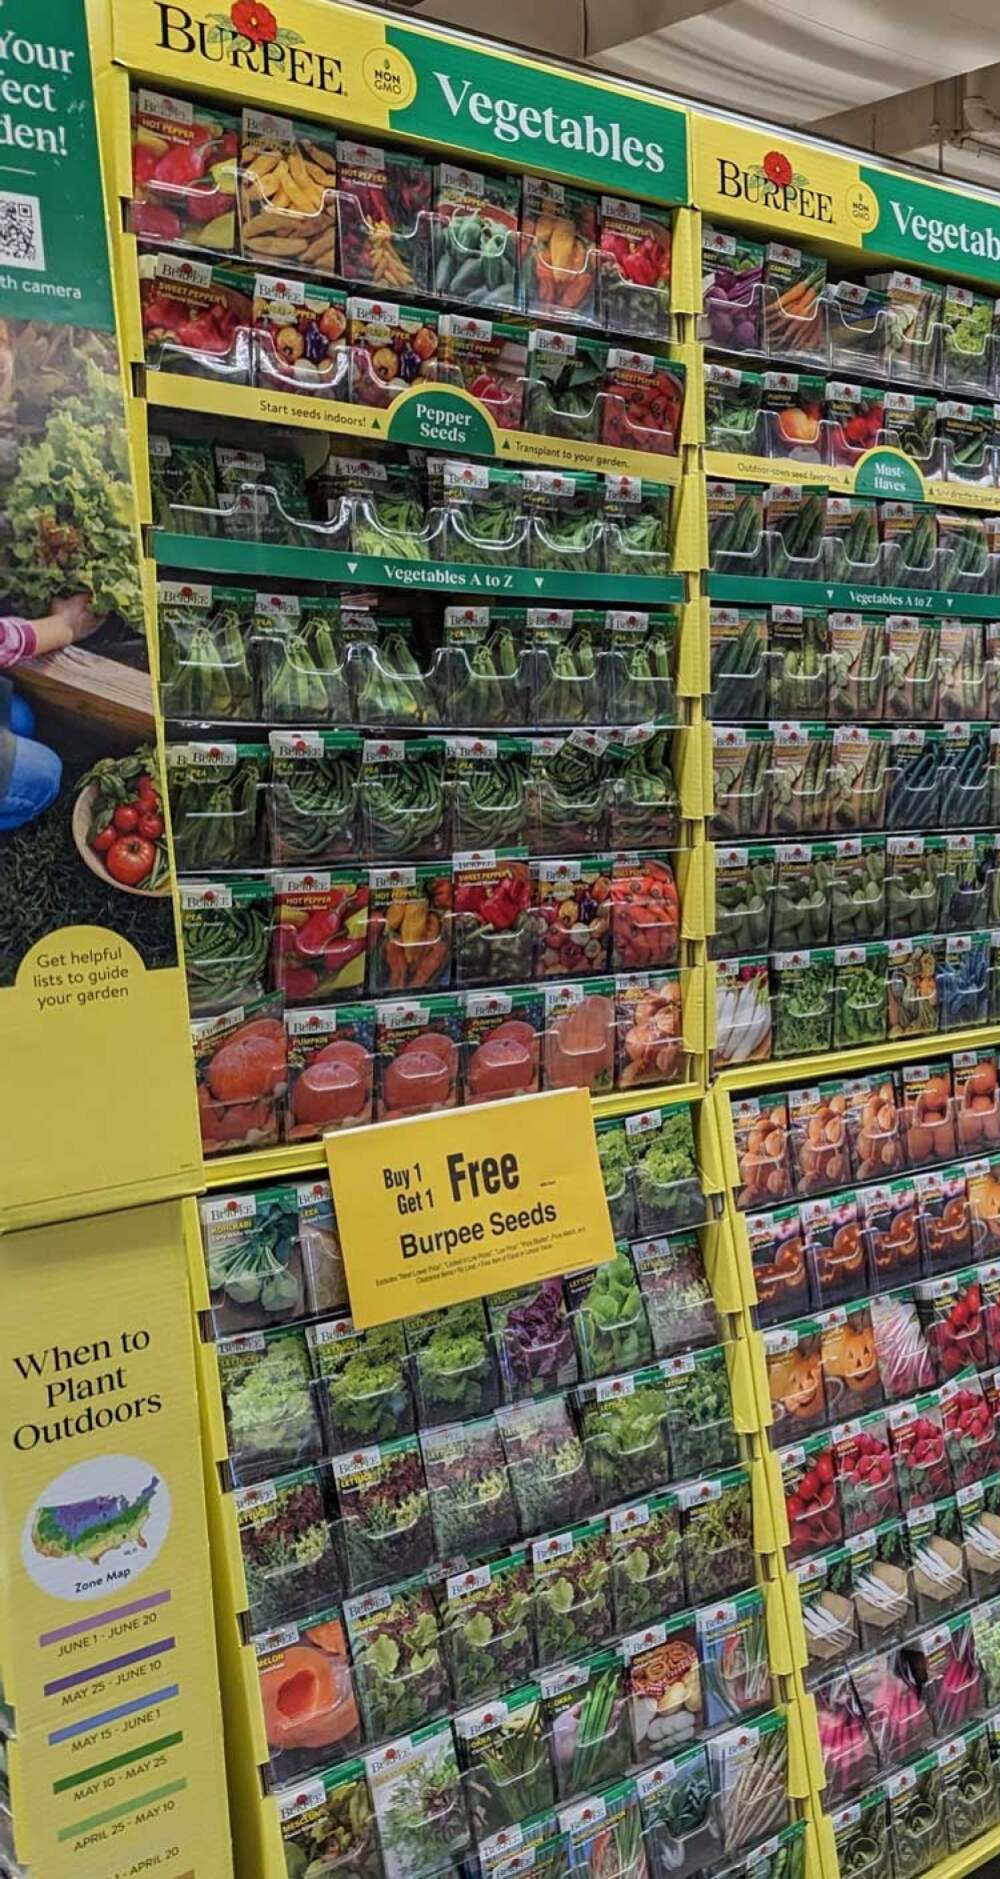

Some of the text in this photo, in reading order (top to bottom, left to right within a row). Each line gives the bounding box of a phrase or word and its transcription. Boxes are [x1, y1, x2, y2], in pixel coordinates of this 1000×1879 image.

[154, 2, 345, 97] BURPEE
[373, 80, 402, 96] GMO
[374, 69, 401, 85] NON
[432, 71, 665, 173] Vegetables
[716, 157, 834, 225] BURPEE
[851, 210, 871, 222] GMO
[852, 202, 871, 214] NON
[22, 277, 82, 300] camera
[259, 400, 367, 428] Start seeds indoors!
[416, 403, 472, 427] Pepper
[420, 423, 467, 444] Seeds
[515, 441, 630, 469] Transplant to your garden.
[872, 476, 907, 493] Haves
[874, 462, 906, 479] Must-
[384, 563, 514, 588] Vegetables A to Z
[850, 590, 933, 608] Vegetables A to Z
[36, 947, 122, 969] Get helpful
[33, 966, 129, 988] lists to guide
[37, 986, 129, 1011] your garden
[383, 1162, 423, 1191] Buy 1
[446, 1152, 520, 1202] Free
[396, 1188, 435, 1217] Get 1
[399, 1222, 485, 1261] Burpee
[488, 1202, 558, 1238] Seeds
[13, 1329, 151, 1382] When to
[45, 1366, 128, 1409] Plant
[13, 1393, 163, 1452] Outdoors
[74, 1568, 132, 1594] Zone Map
[57, 1612, 158, 1659] JUNE 1 JUNE 20
[61, 1660, 163, 1708] MAY 25 JUNE 10
[71, 1733, 98, 1753] MAY
[100, 1727, 113, 1742] 15
[122, 1713, 154, 1735] JUNE
[73, 1756, 168, 1803] MAY 10 MAY 25
[73, 1800, 176, 1853] APRIL 25 MAY 10
[129, 1846, 180, 1877] APRIL 20
